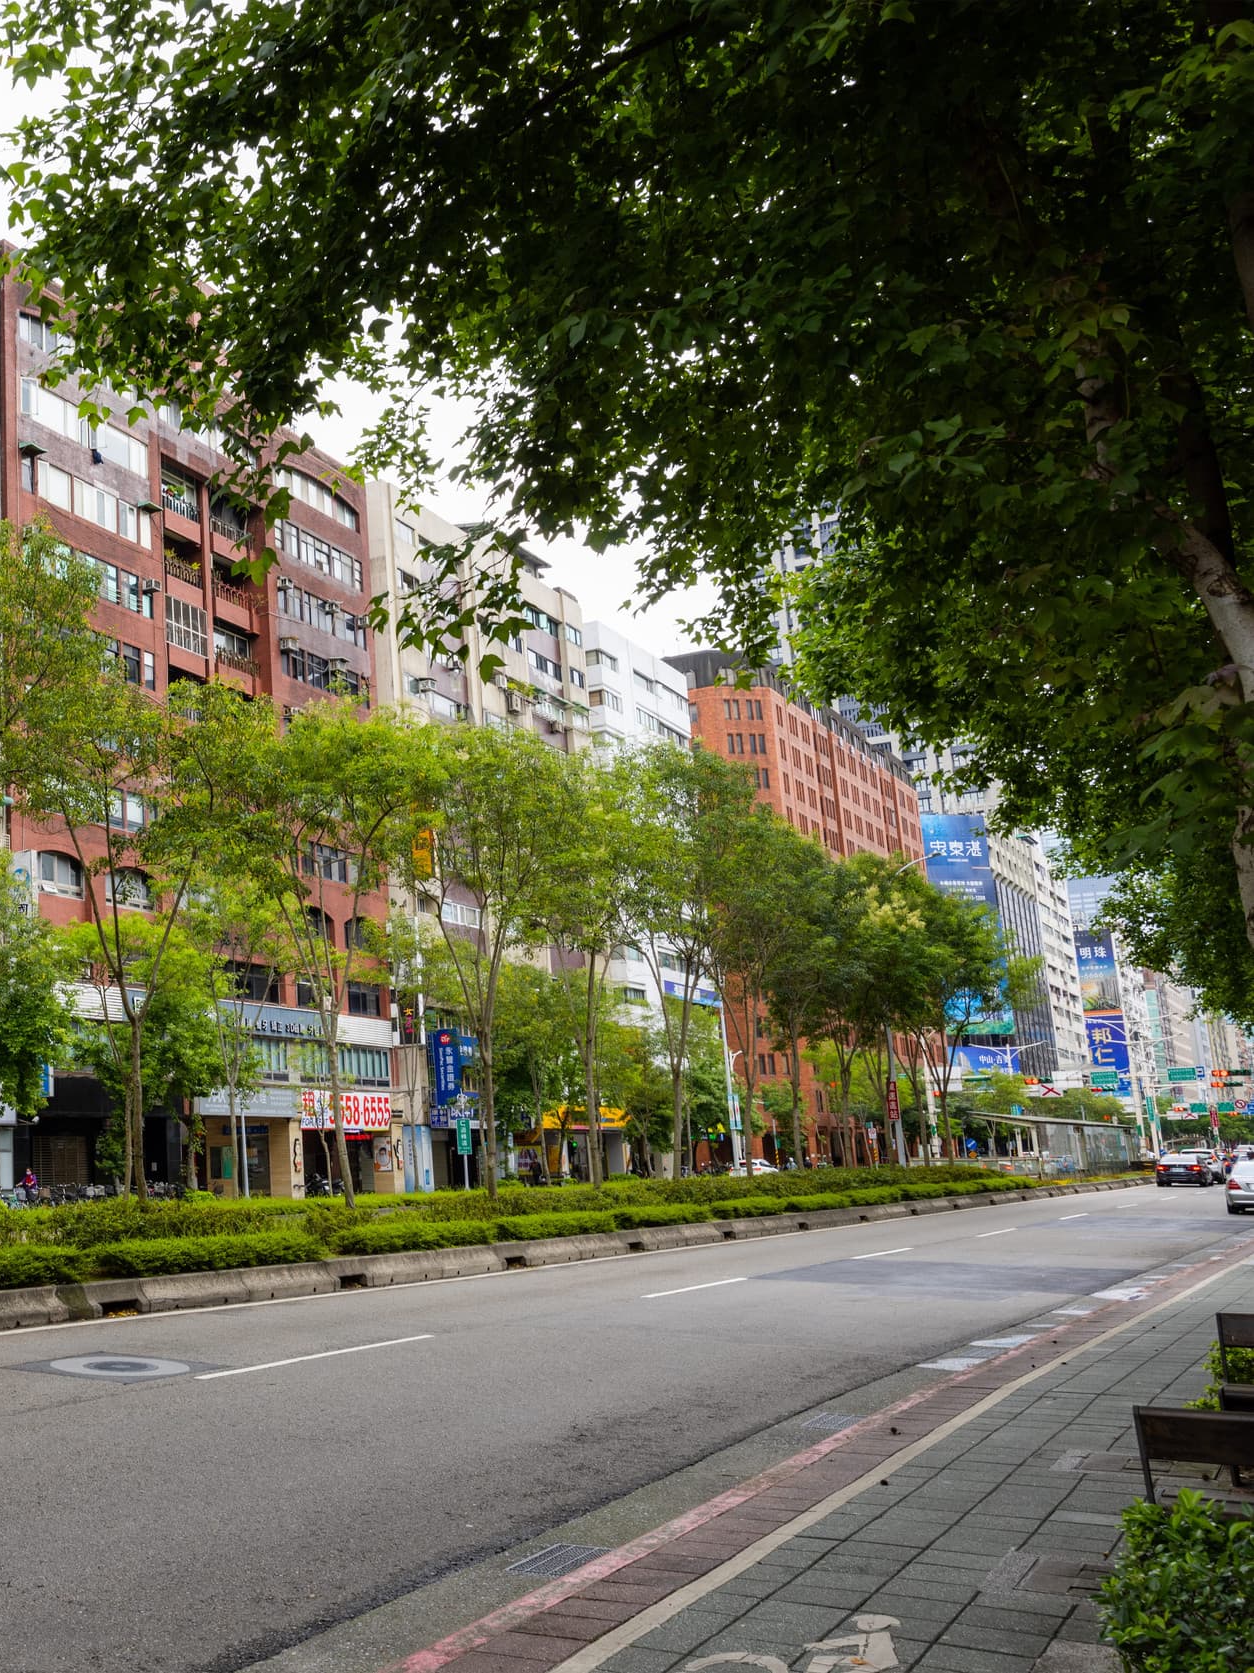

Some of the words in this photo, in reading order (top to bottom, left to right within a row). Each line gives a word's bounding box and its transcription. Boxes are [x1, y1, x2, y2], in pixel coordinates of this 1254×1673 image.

[1079, 946, 1107, 959] 明珠
[1086, 1027, 1112, 1045] 邦
[1089, 1047, 1116, 1064] 仁
